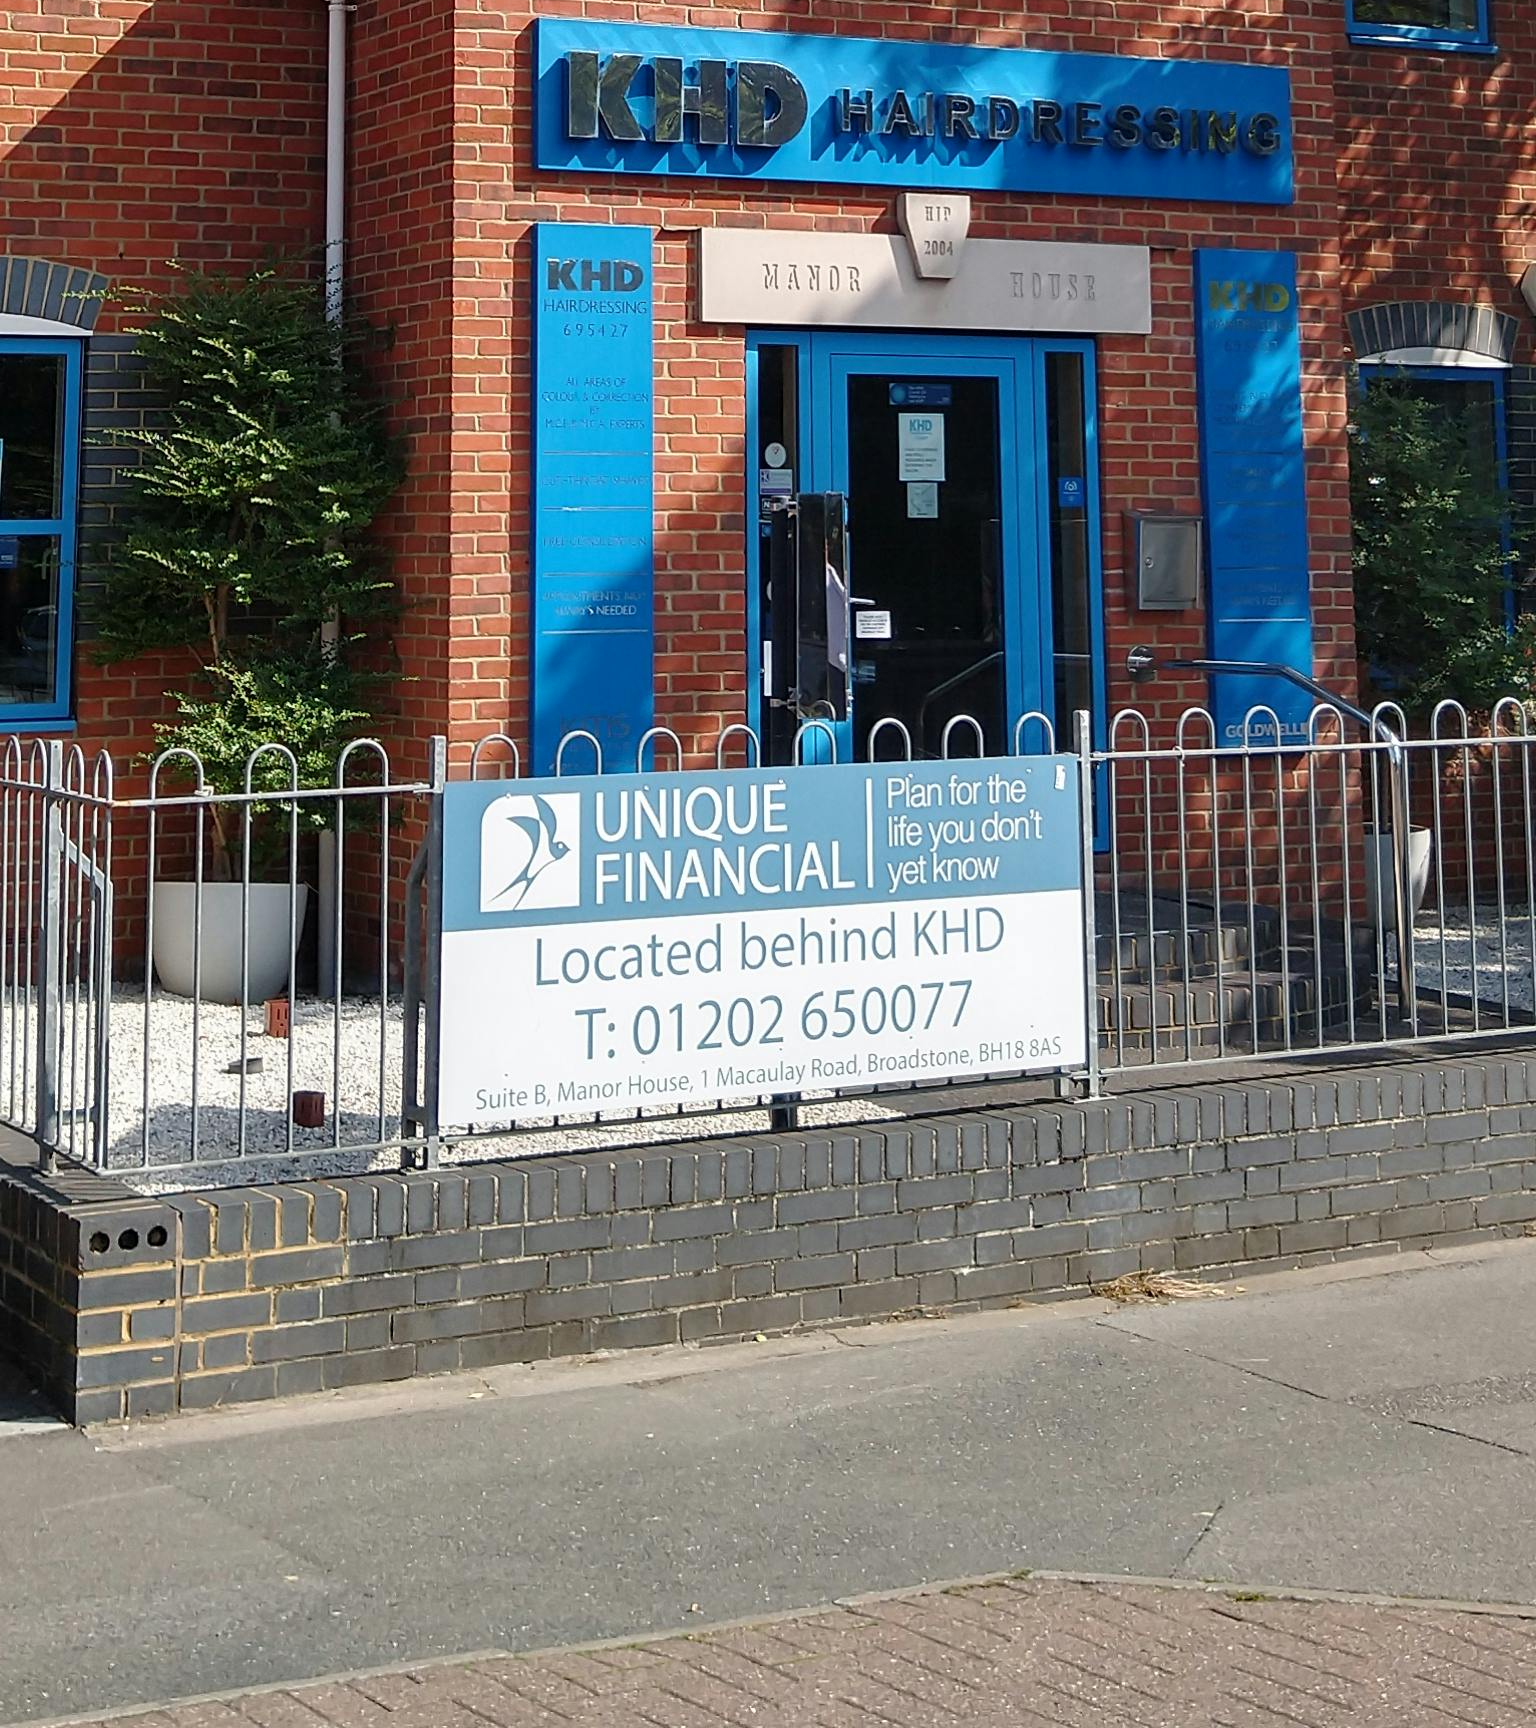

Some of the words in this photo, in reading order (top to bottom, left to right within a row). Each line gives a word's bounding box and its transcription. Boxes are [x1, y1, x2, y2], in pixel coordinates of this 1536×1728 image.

[567, 50, 809, 148] KHD
[838, 87, 1282, 156] HAIRDRESSING
[924, 240, 954, 257] 2004
[547, 257, 644, 292] KHD
[762, 263, 861, 292] MANOR
[1010, 272, 1097, 302] HOUSE
[543, 299, 648, 314] HAIRDRESSING
[1209, 280, 1290, 312] KHD
[563, 323, 628, 337] 695427
[595, 604, 638, 616] NEEDED
[887, 775, 942, 810] Plan
[948, 775, 981, 806] for
[987, 773, 1026, 804] the
[595, 780, 789, 843] UNIQUE
[887, 813, 925, 849] life
[929, 818, 977, 856] you
[981, 810, 1044, 843] don't
[594, 841, 855, 905] FINANCIAL
[887, 856, 928, 893] yet
[931, 854, 1000, 884] know
[535, 922, 723, 986] Located
[740, 912, 896, 971] behind
[914, 907, 1005, 956] KHD
[575, 1007, 616, 1060] T:
[632, 994, 784, 1056] 01202
[800, 980, 973, 1041] 650077
[476, 1084, 529, 1112] Suite
[533, 1082, 551, 1108] B,
[557, 1076, 622, 1105] Manor
[628, 1071, 694, 1100] House,
[701, 1068, 709, 1090] 1
[716, 1060, 805, 1096] Macaulay
[811, 1055, 862, 1081] Road,
[867, 1048, 972, 1075] Broadstone,
[978, 1040, 1025, 1063] BH18
[1029, 1035, 1062, 1059] 8AS
